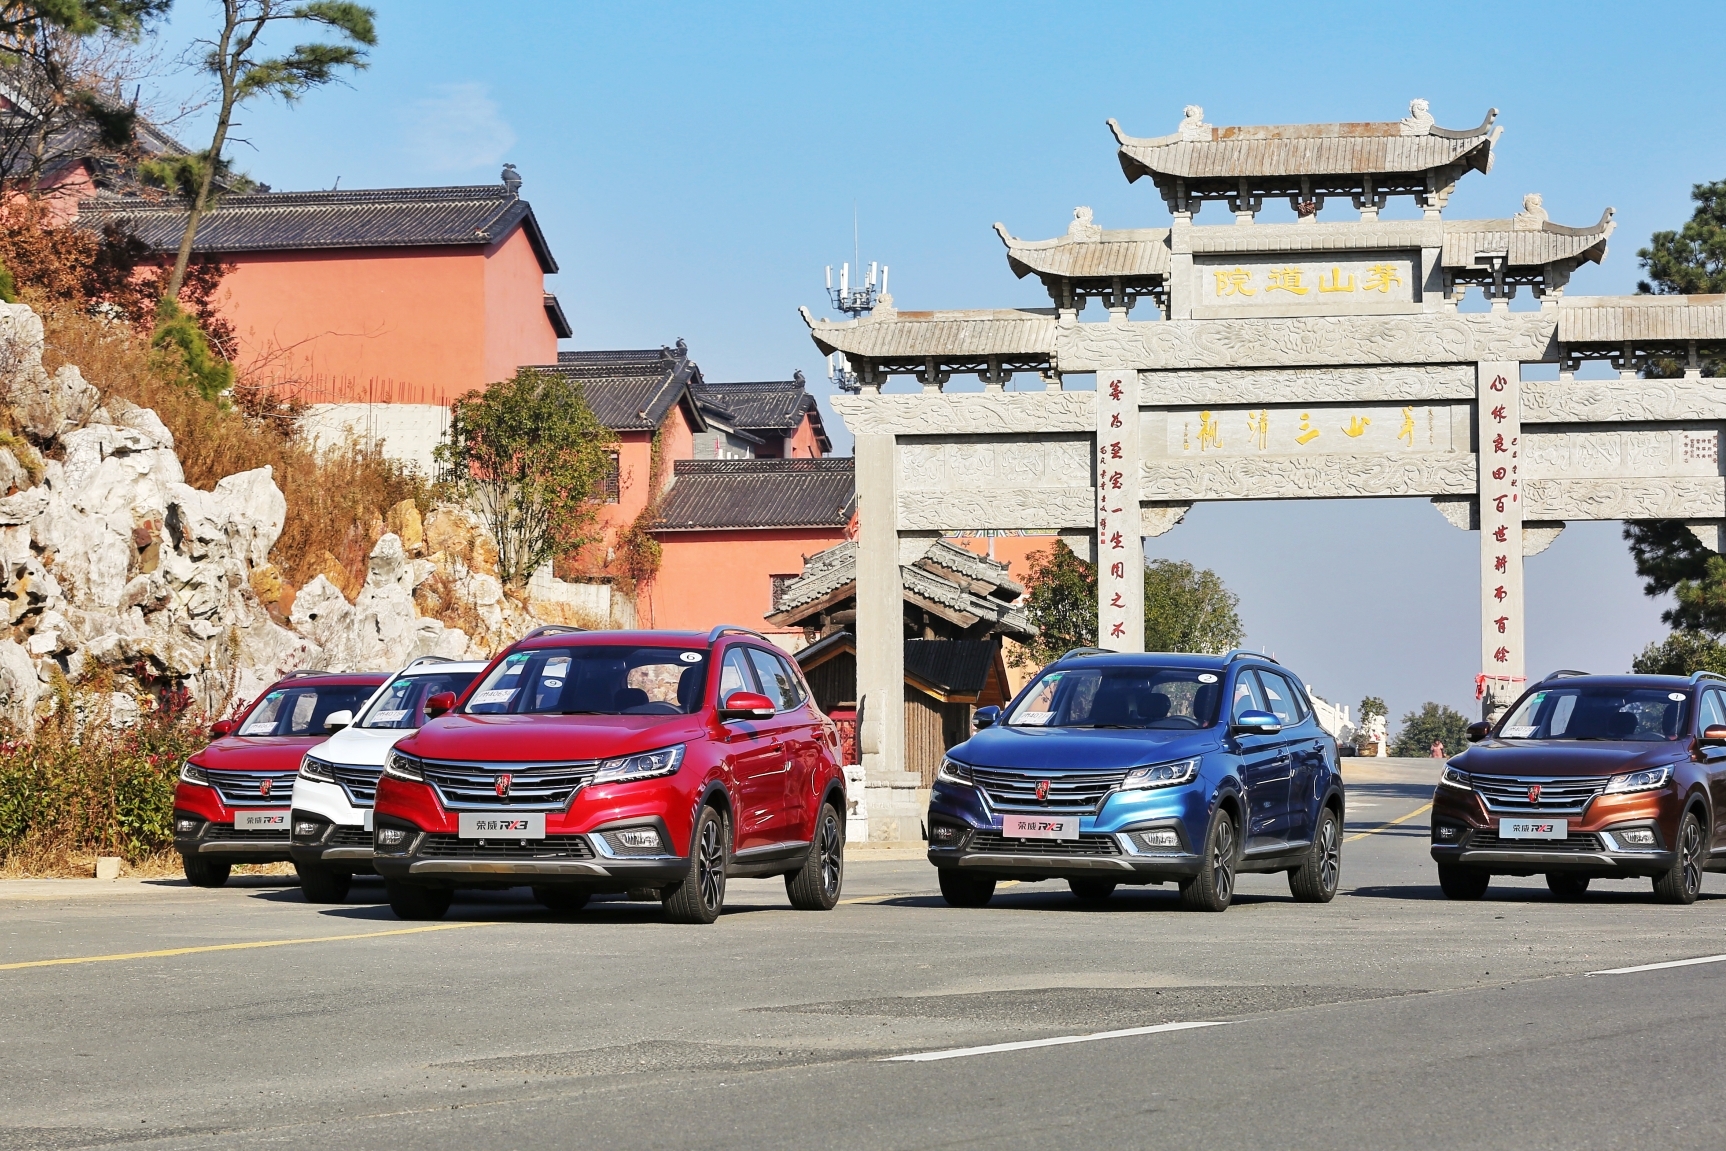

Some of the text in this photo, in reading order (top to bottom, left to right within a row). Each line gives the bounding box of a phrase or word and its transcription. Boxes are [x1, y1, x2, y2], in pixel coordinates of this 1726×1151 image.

[246, 816, 284, 824] 荣威 RX3
[476, 820, 528, 830] 荣威 RX3
[1017, 821, 1064, 832] 荣威 RX3
[1513, 824, 1554, 832] 荣威 RX3
